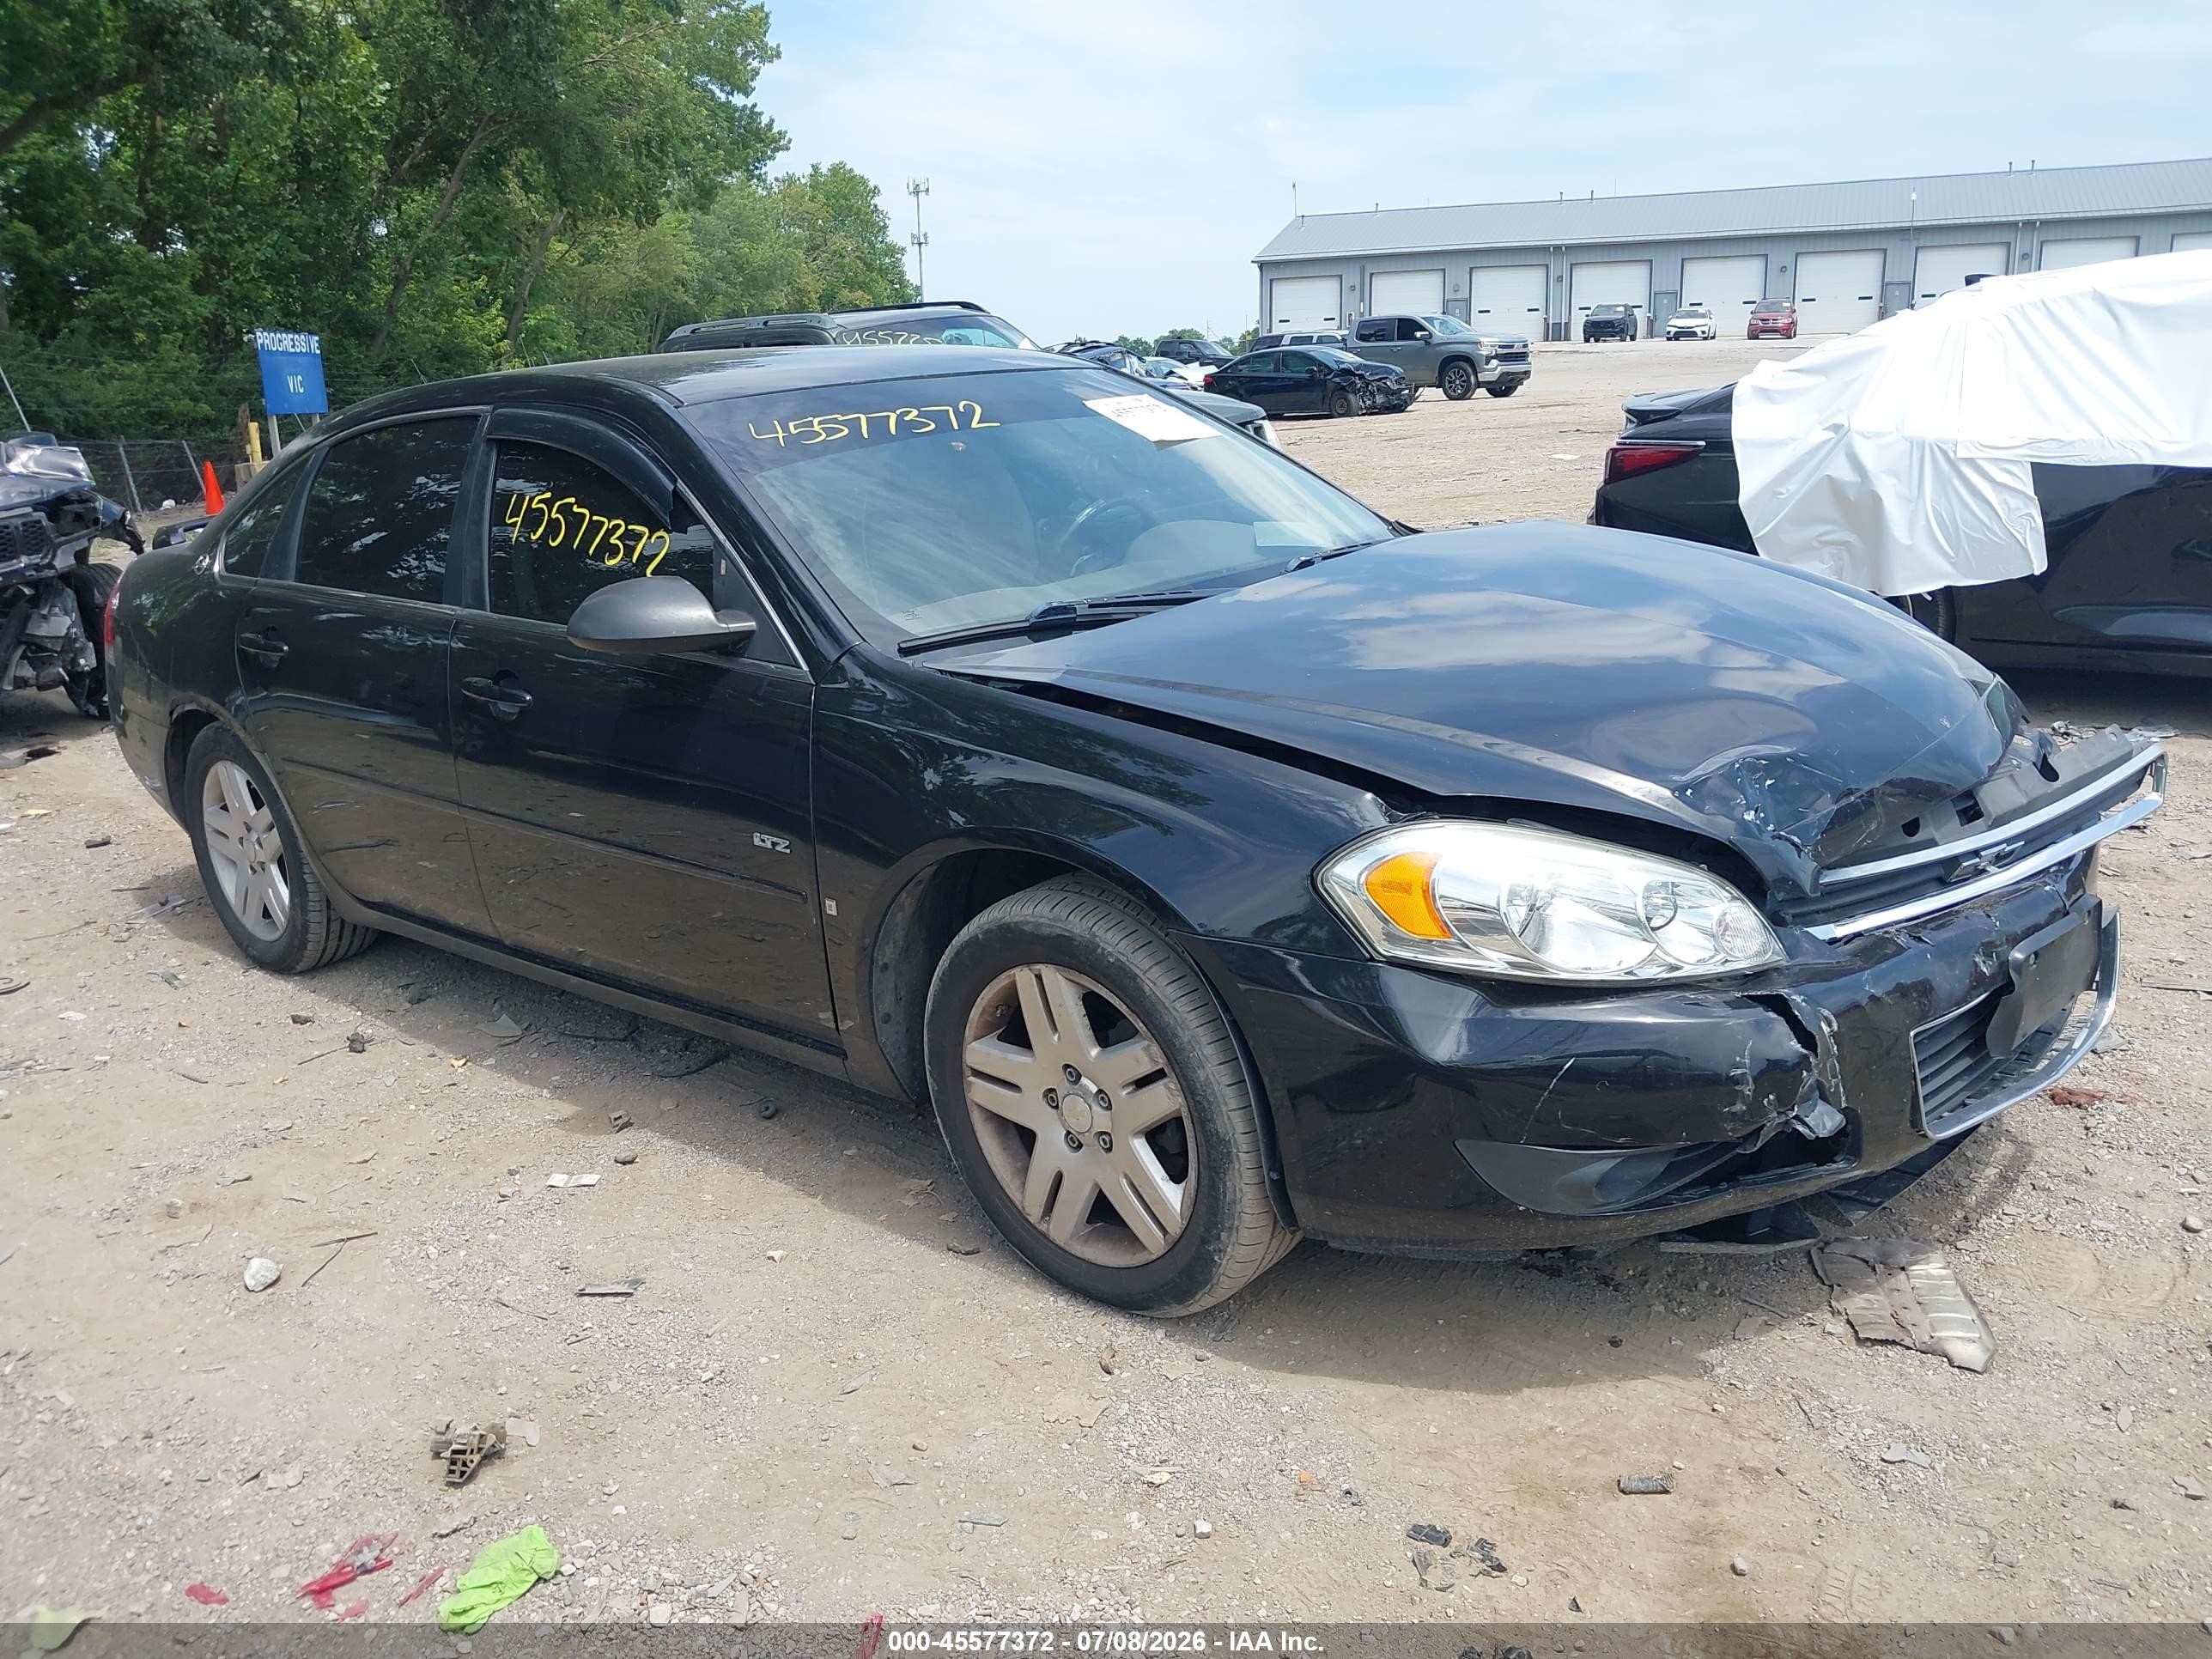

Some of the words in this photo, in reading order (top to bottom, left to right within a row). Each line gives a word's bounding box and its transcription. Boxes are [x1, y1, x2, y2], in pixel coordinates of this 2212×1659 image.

[255, 331, 321, 355] PROGRESSIVE
[287, 374, 305, 393] VIC
[749, 399, 1001, 447] 45577372
[505, 491, 670, 578] 45577372
